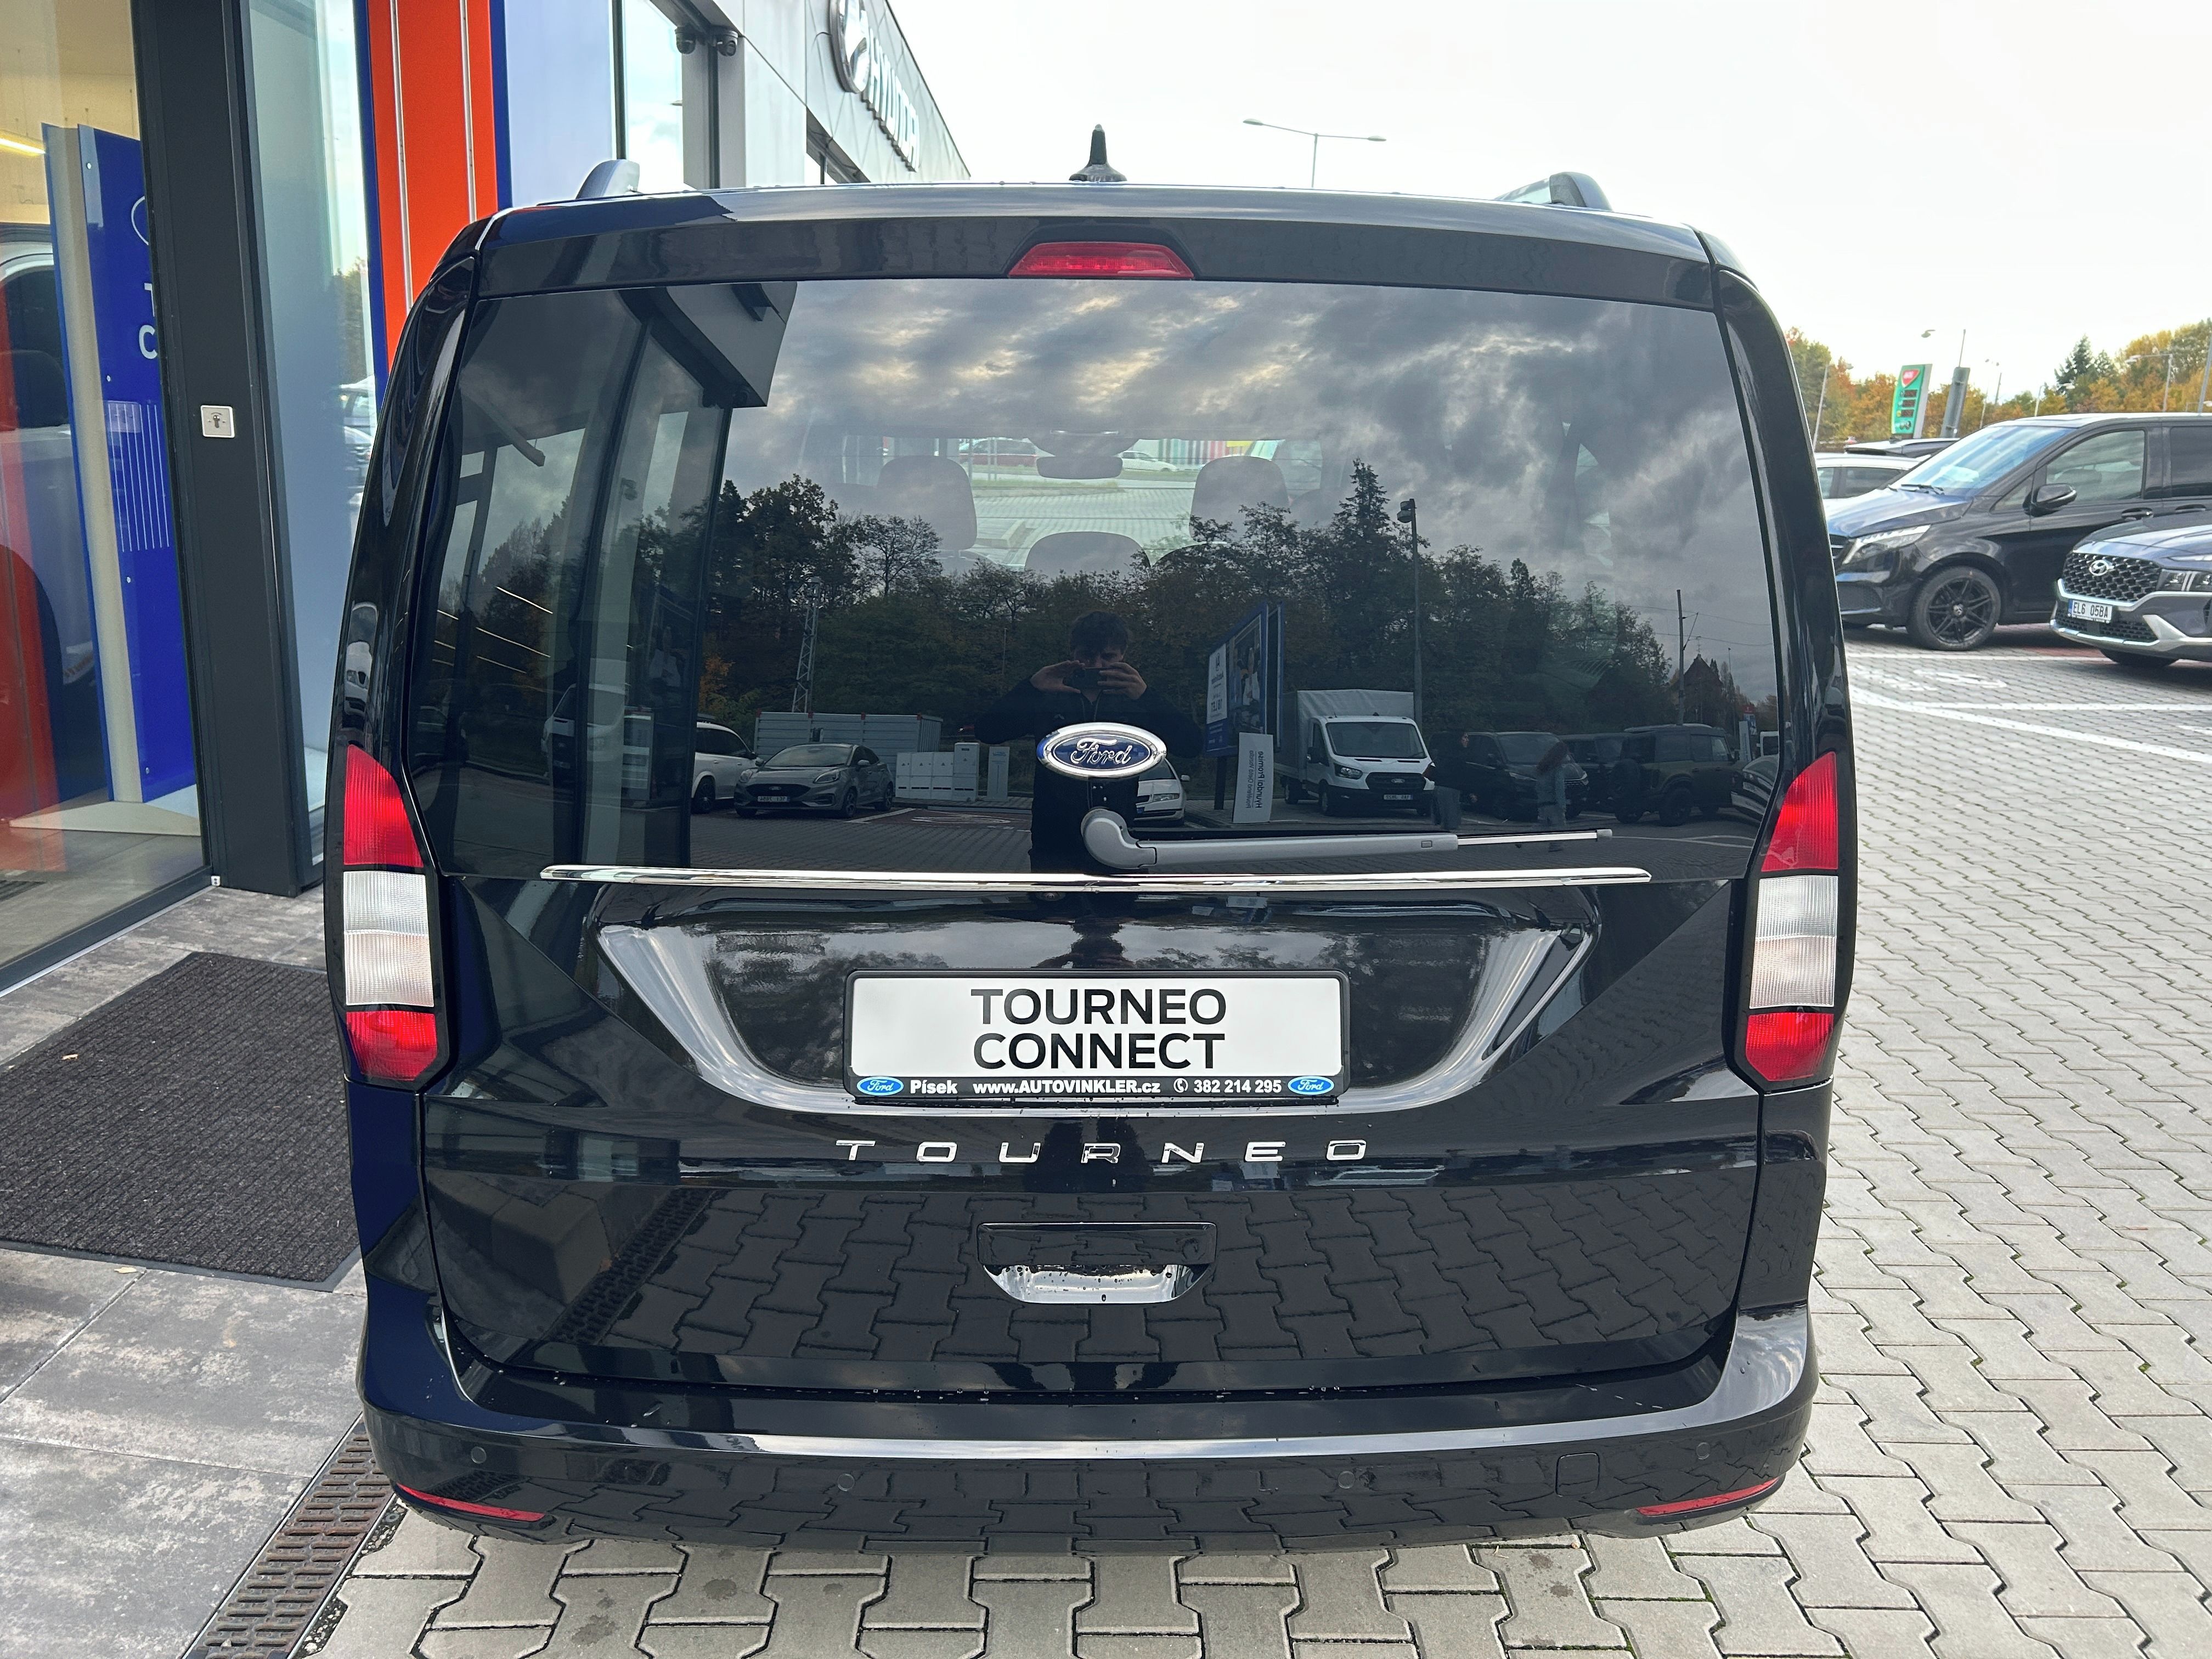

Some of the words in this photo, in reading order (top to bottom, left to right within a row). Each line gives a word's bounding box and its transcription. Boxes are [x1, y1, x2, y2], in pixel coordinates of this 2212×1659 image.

[2073, 602, 2086, 614] EL6
[2090, 605, 2108, 618] 05BA
[1070, 737, 1133, 765] Ford
[970, 989, 1226, 1025] TOURNEO
[974, 1032, 1225, 1069] CONNECT
[910, 1079, 958, 1094] Písek
[972, 1079, 1161, 1094] www.AUTOVINKLER.cz
[1194, 1079, 1221, 1093] 382
[1224, 1079, 1251, 1093] 214
[1255, 1079, 1282, 1093] 295
[836, 1139, 1367, 1164] TOURNEO
